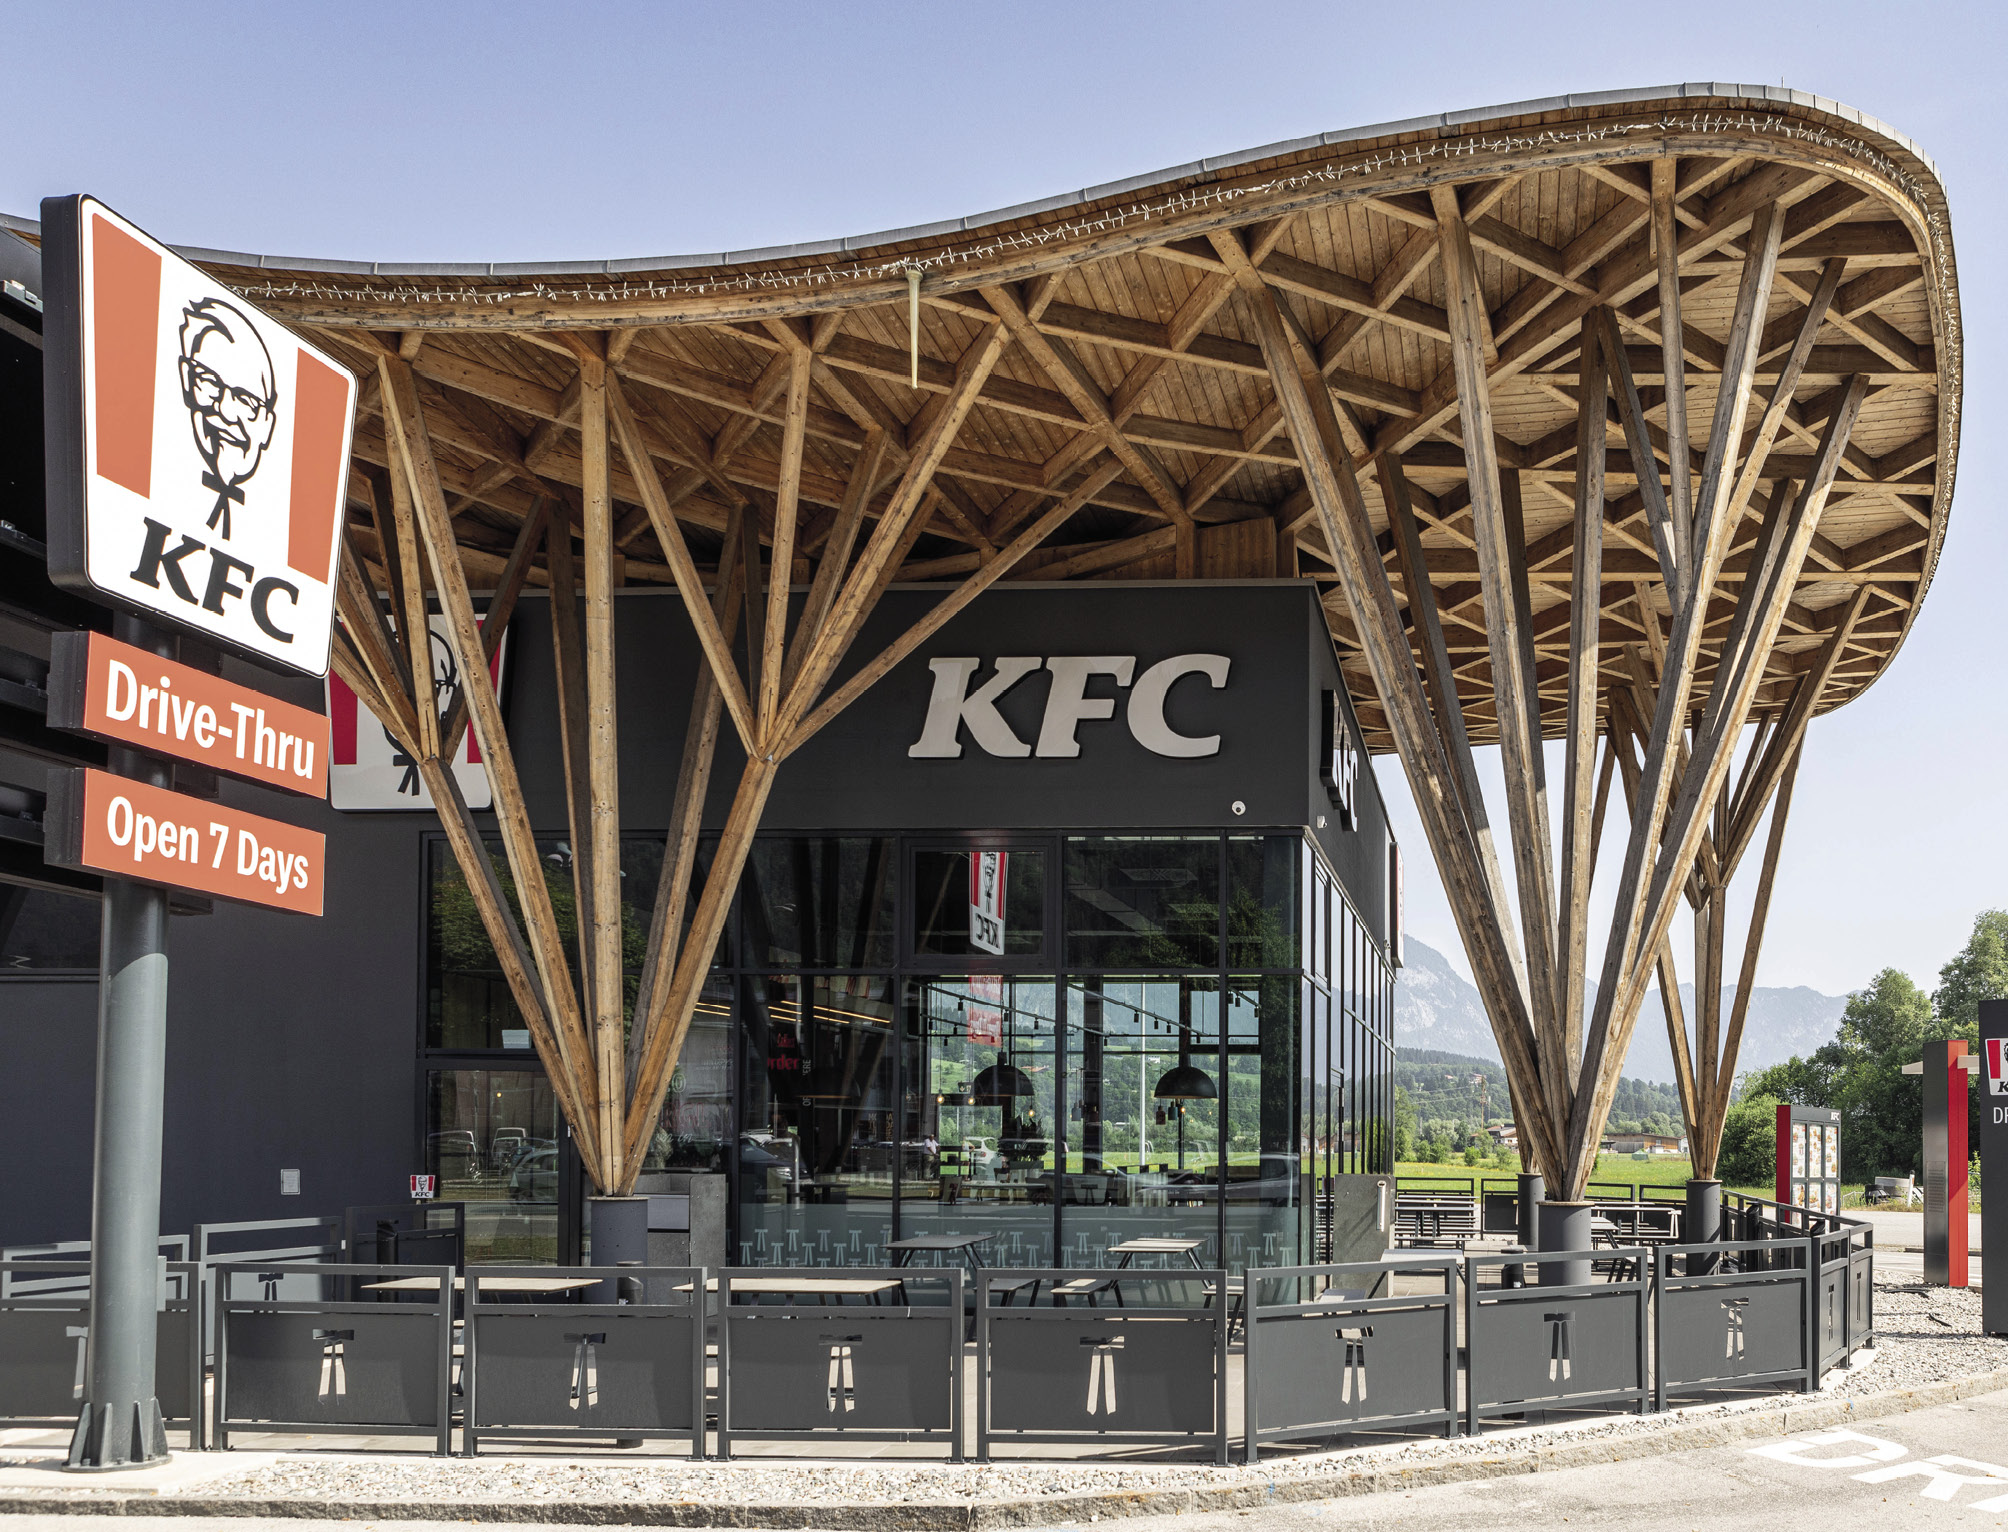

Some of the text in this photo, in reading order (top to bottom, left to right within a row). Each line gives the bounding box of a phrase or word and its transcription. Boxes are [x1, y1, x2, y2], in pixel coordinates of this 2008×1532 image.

[130, 517, 299, 643] KFC
[106, 658, 315, 780] Drive-Thru
[908, 653, 1231, 758] KFC
[107, 795, 309, 894] Open 7 Days
